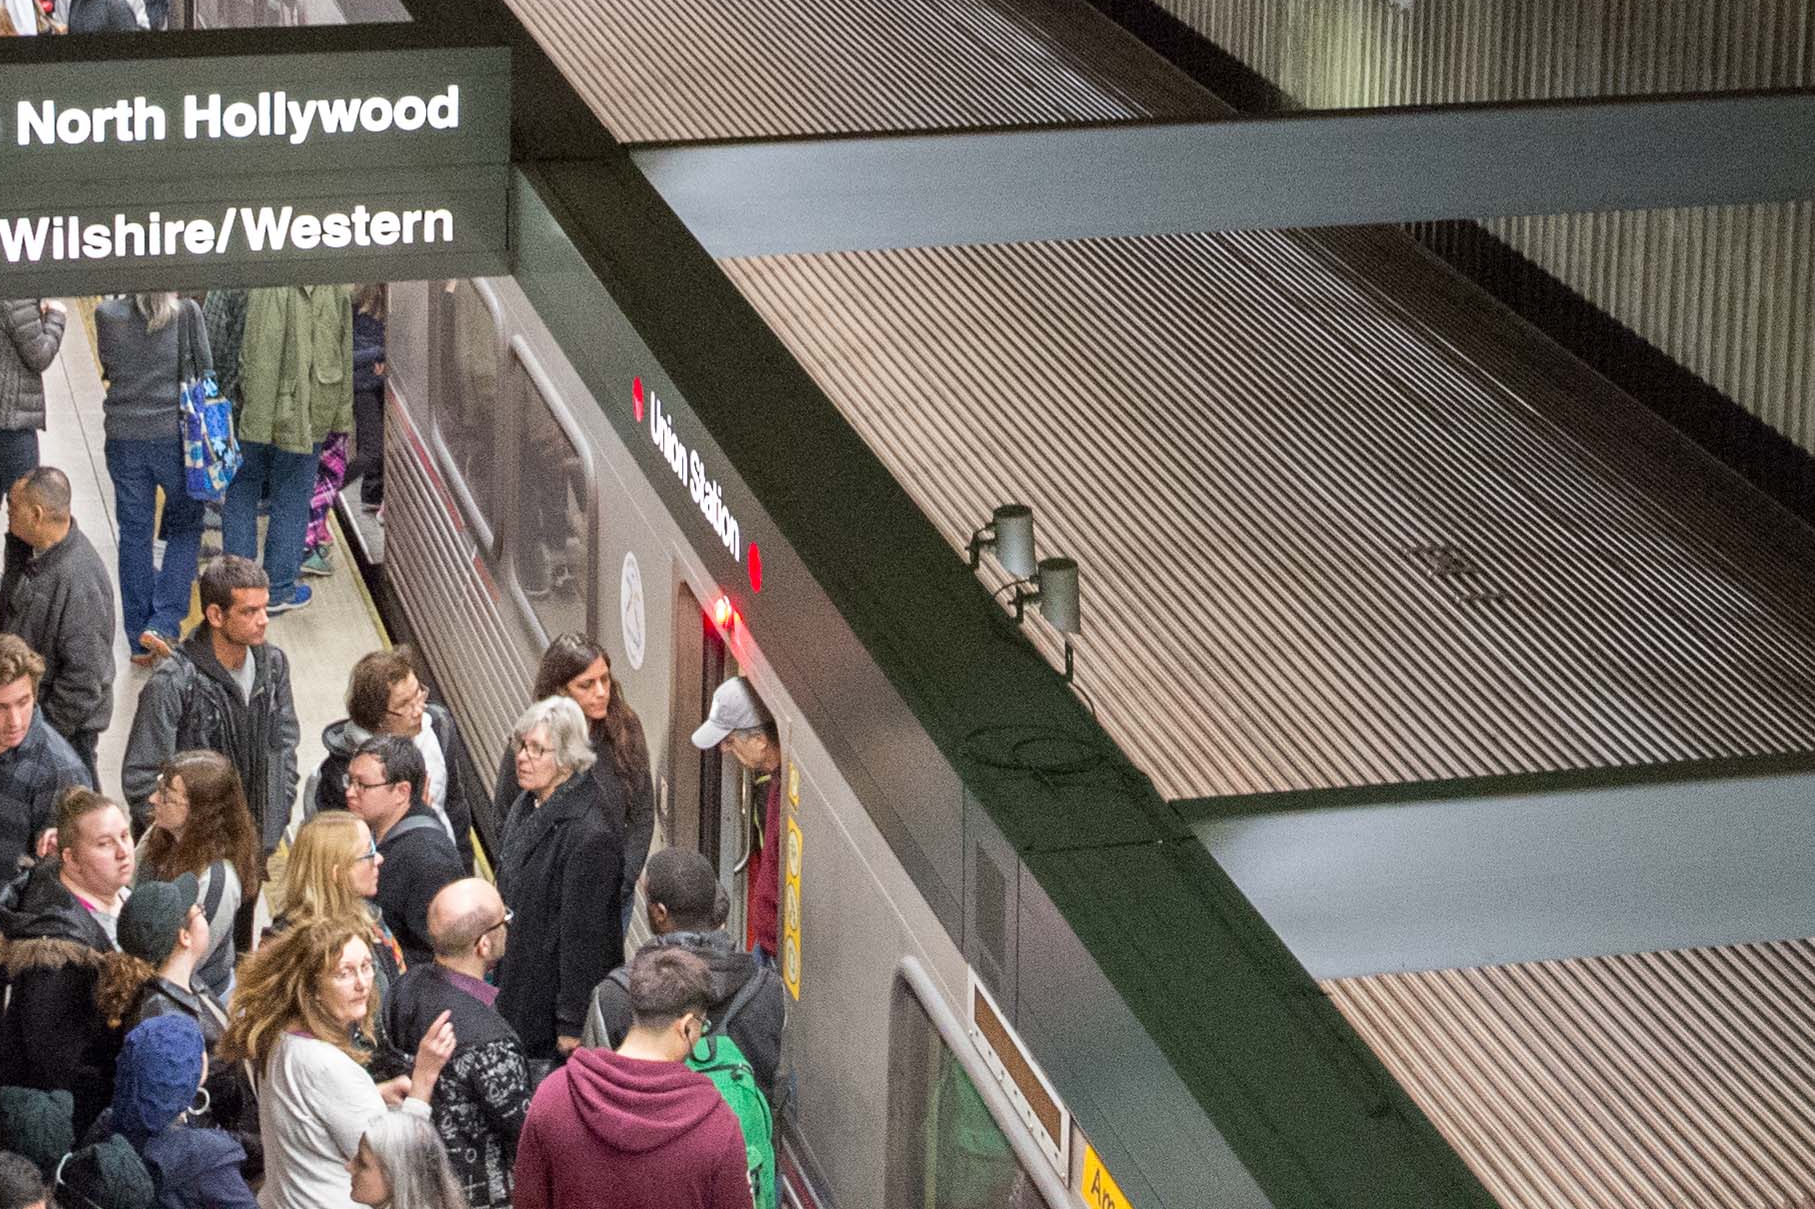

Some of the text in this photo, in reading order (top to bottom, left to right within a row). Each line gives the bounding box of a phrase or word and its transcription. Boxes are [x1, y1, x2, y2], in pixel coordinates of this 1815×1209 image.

[17, 96, 166, 146] North
[183, 84, 459, 145] Hollywood
[650, 391, 740, 562] Union Station
